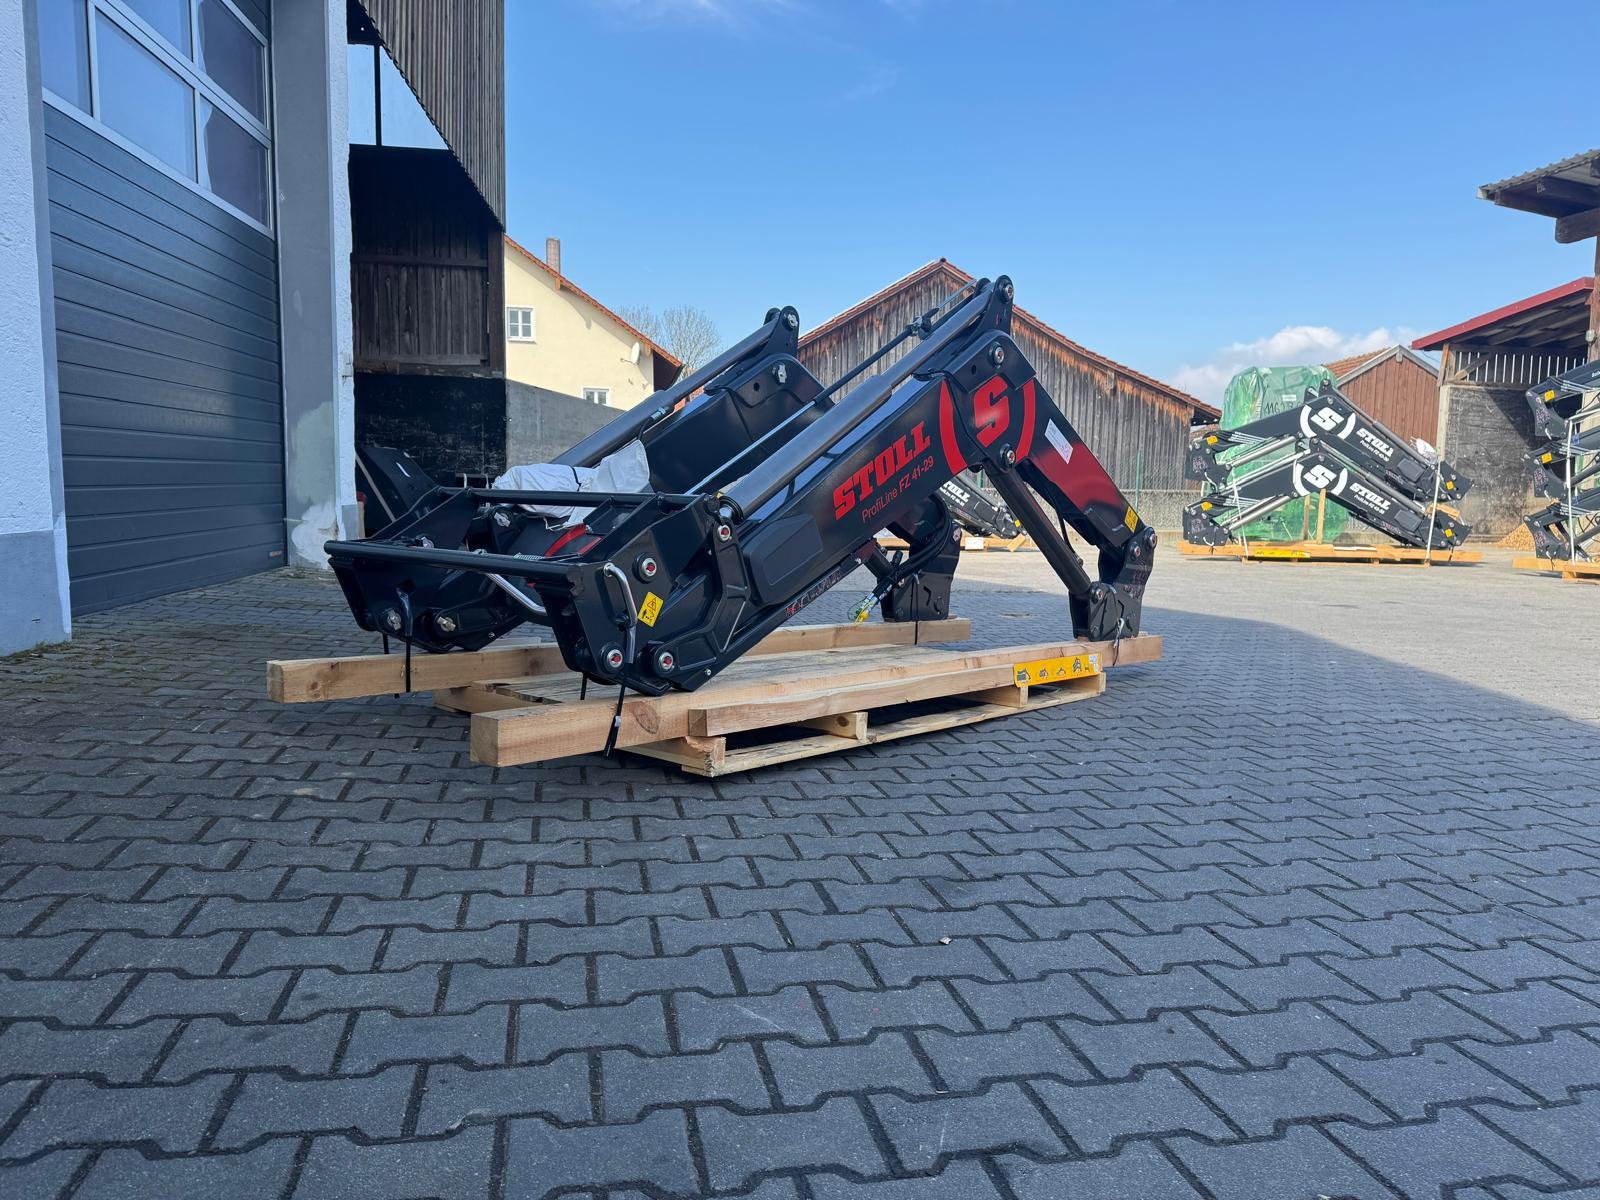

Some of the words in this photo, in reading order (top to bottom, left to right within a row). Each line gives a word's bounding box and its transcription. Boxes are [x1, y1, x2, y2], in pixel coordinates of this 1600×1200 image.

[832, 421, 931, 521] STOLL
[861, 488, 898, 523] ProfiLine
[899, 474, 912, 493] FZ
[912, 455, 934, 480] 41-29
[943, 480, 971, 503] TOLL
[1350, 482, 1392, 510] STOLL
